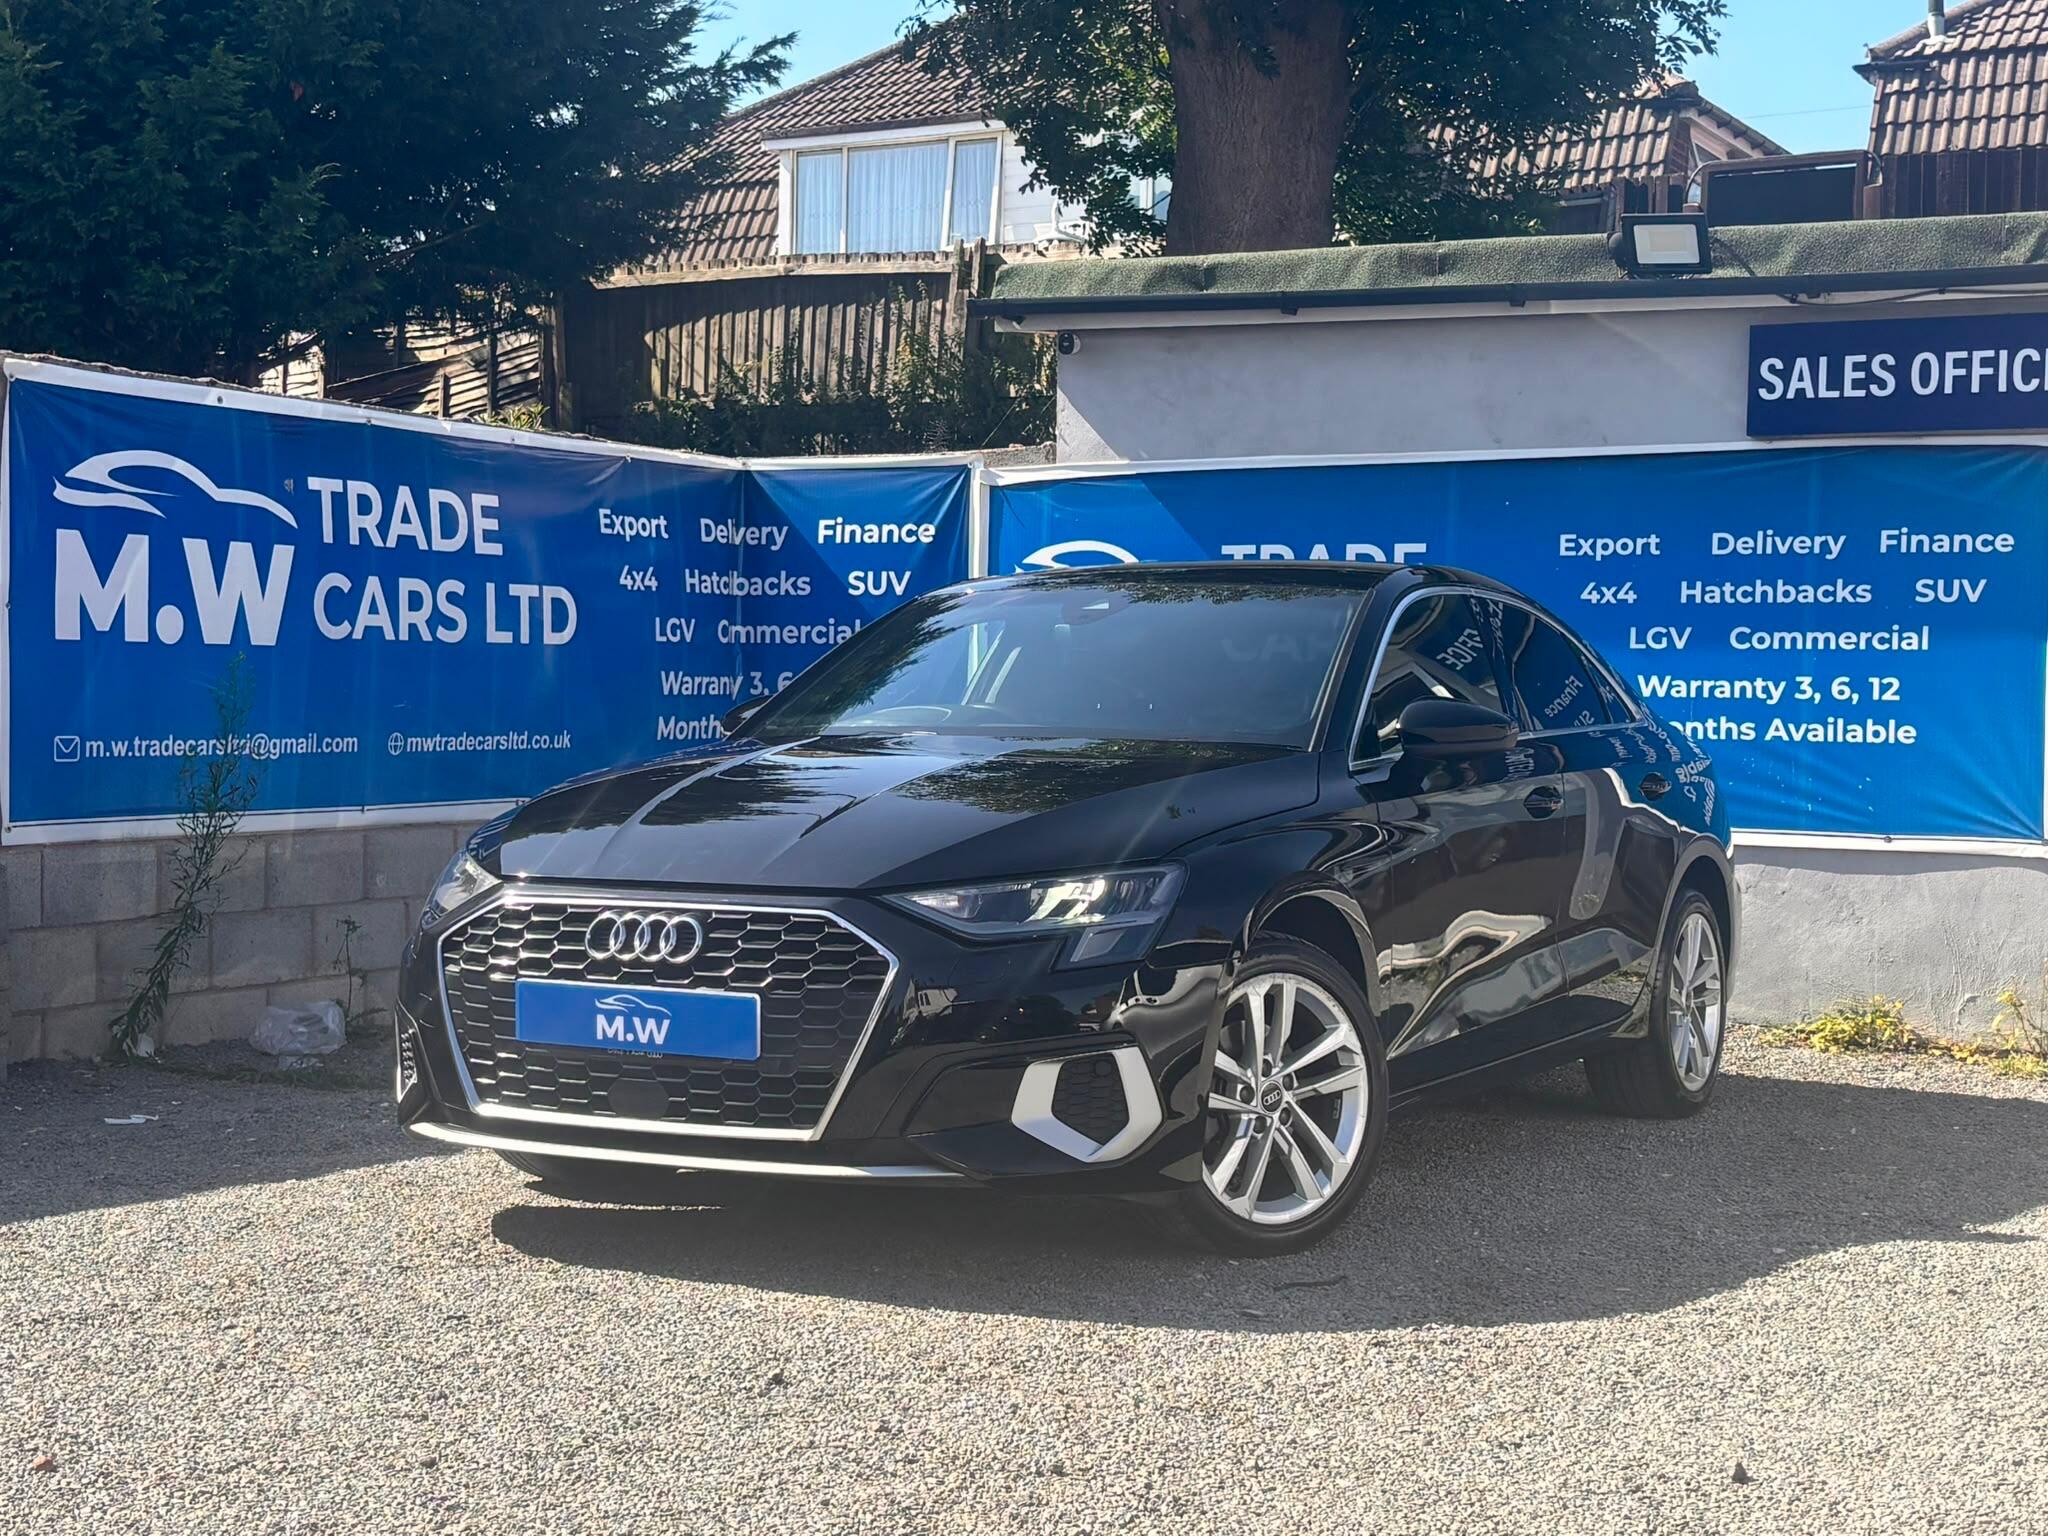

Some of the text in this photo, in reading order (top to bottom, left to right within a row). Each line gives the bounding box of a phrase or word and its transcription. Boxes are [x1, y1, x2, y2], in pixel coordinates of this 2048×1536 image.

[1758, 347, 2048, 401] SALES OFFIC
[307, 476, 503, 556] TRADE
[599, 508, 669, 541] Export
[818, 517, 936, 544] Finance
[1559, 527, 2015, 561] Export Delivery Finance
[54, 528, 295, 646] M.W
[619, 564, 658, 592] 4x4
[848, 570, 912, 596] SUV
[1580, 578, 1987, 604] 4x4 Hatchbacks SUV
[313, 572, 577, 645] CARS LTD
[655, 616, 696, 643] LGV
[1629, 625, 1929, 651] LGV Commercial
[1637, 674, 1901, 705] Warranty 3, 6, 12
[406, 730, 571, 754] mwtradecarsltd.co.uk
[656, 713, 724, 739] Month
[1667, 716, 1756, 740] nths
[1764, 716, 1917, 744] Available
[596, 1013, 671, 1045] M.W
